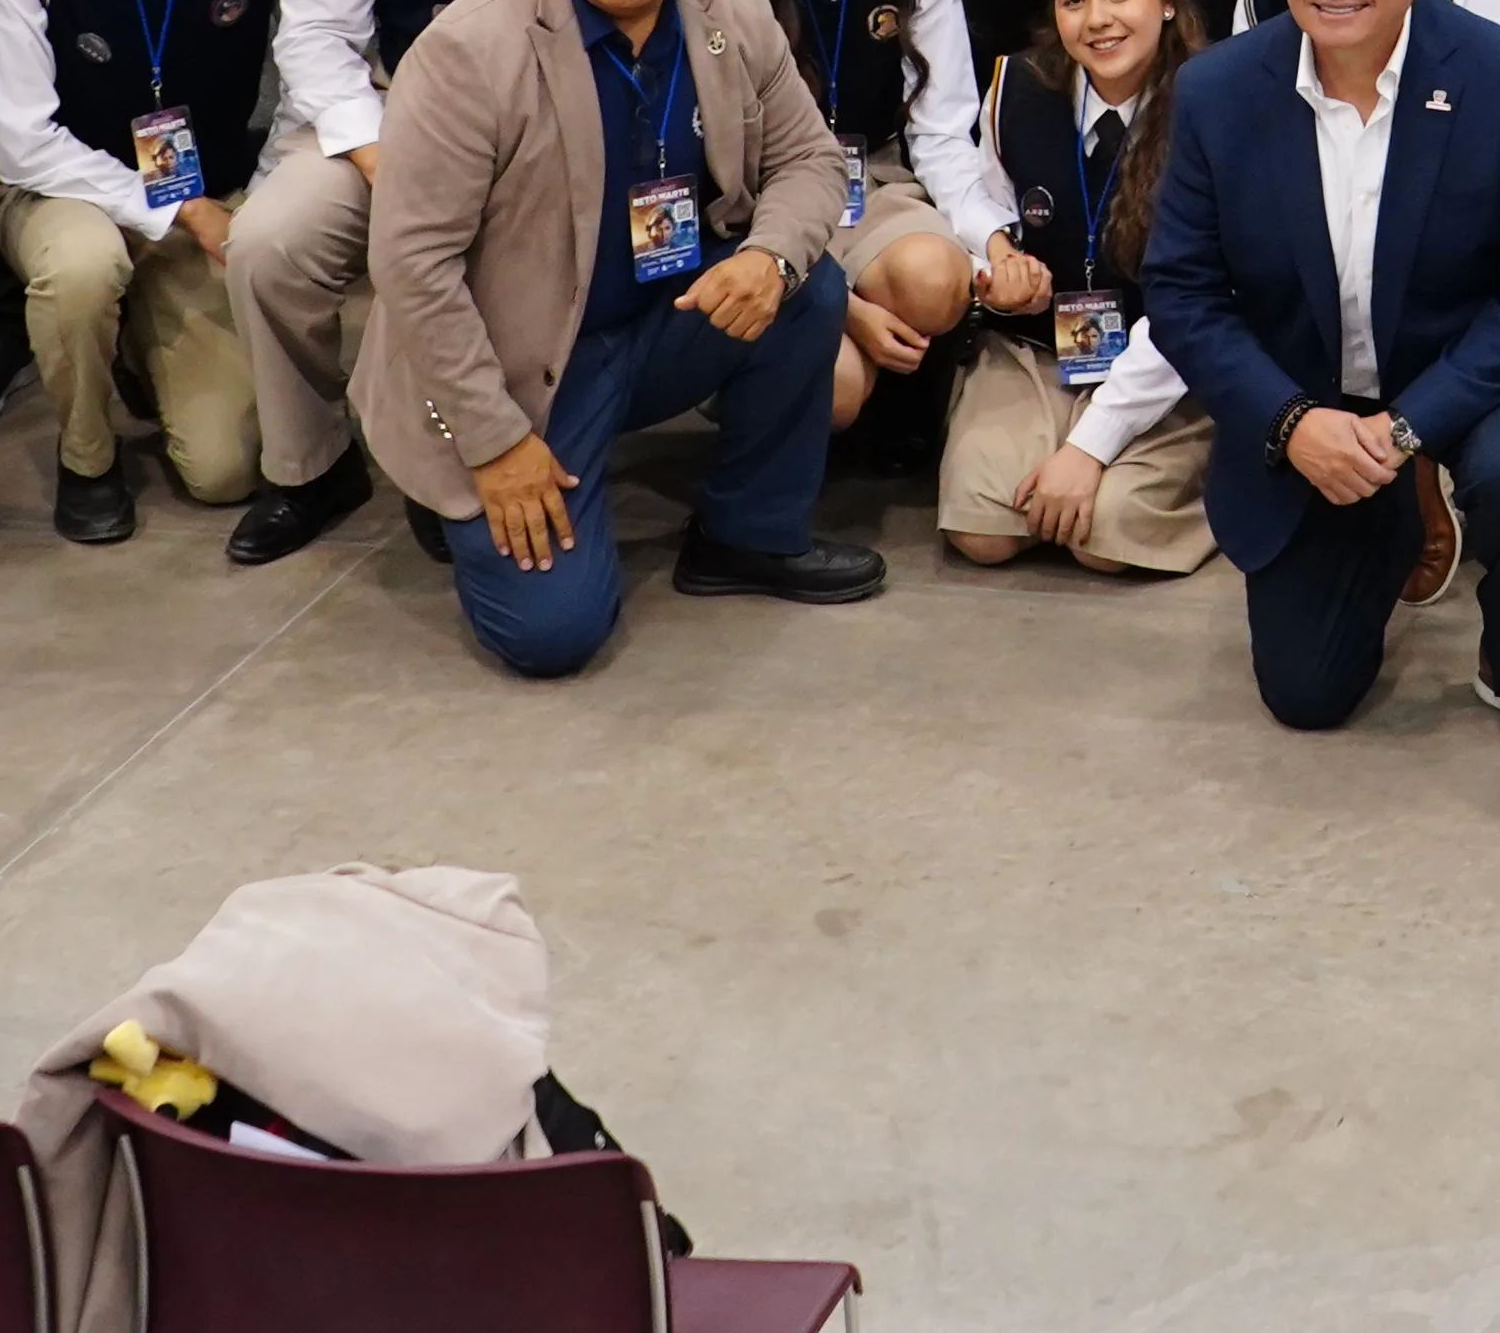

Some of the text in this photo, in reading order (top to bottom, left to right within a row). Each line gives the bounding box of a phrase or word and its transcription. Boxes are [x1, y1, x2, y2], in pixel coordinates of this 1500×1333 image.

[632, 188, 690, 207] RETO MARTE
[1058, 300, 1117, 312] RETO MARTE
